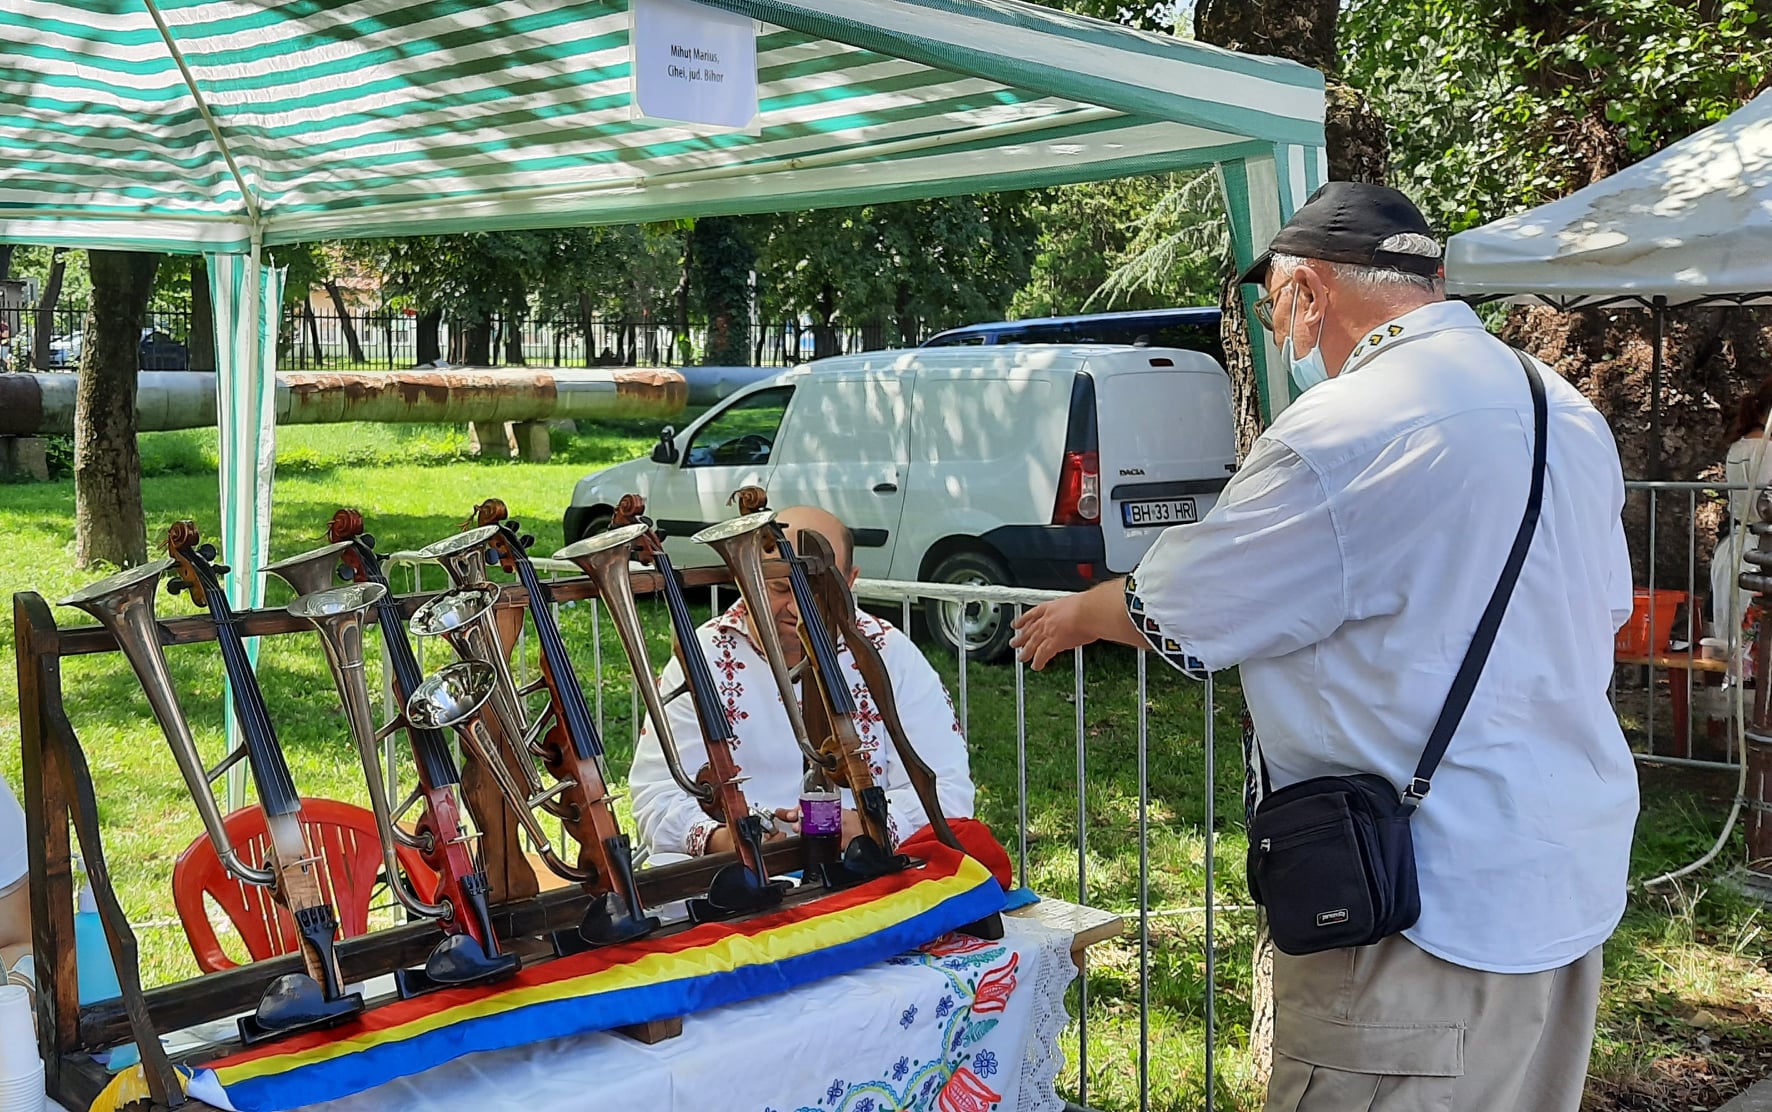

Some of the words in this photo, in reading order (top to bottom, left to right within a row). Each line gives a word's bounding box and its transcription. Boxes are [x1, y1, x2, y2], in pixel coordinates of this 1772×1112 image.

[693, 47, 720, 65] Marius,
[667, 64, 688, 81] Cihei,
[688, 67, 703, 82] jud.
[704, 69, 724, 83] Bihor
[1119, 468, 1145, 476] DACIA
[1131, 504, 1151, 522] BH
[1155, 504, 1170, 520] 33
[1174, 502, 1194, 520] HRI
